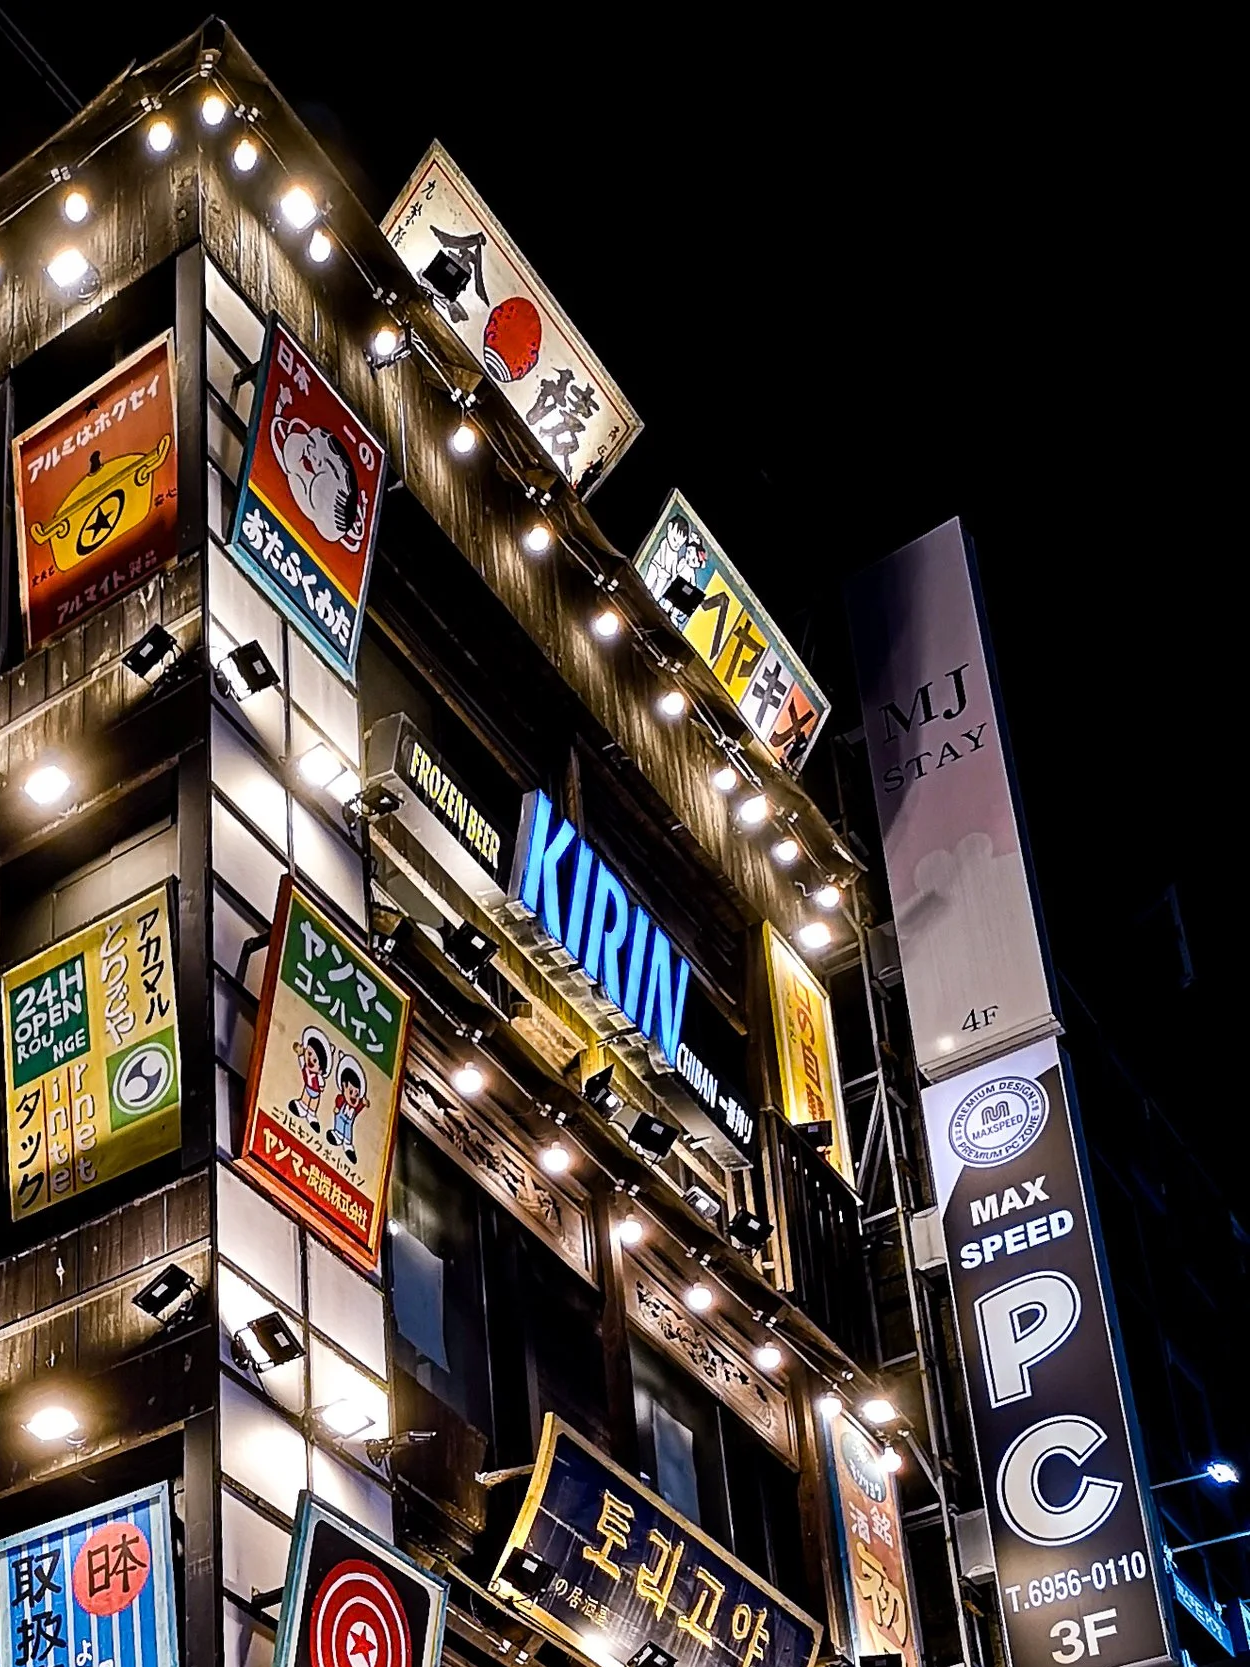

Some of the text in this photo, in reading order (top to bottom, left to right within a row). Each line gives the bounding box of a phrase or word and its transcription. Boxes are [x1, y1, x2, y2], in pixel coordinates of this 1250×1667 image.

[277, 339, 312, 397] 日本
[878, 663, 970, 745] MJ
[881, 723, 988, 794] STAY
[410, 742, 501, 869] FROZEN BEER
[522, 790, 690, 1068] KIRIN
[14, 958, 85, 1016] 24H
[300, 920, 392, 1024] ヤンマー
[14, 992, 83, 1044] OPEN
[961, 1005, 1000, 1033] 4F
[955, 1082, 1036, 1128] PREMIUM DESIGN
[972, 1114, 1023, 1140] MAXSPEED
[968, 1175, 1050, 1227] MAX
[959, 1209, 1076, 1272] SPEED
[86, 1534, 149, 1597] 日本
[1006, 1550, 1147, 1614] T.6956-0110
[1049, 1607, 1118, 1666] 3F
